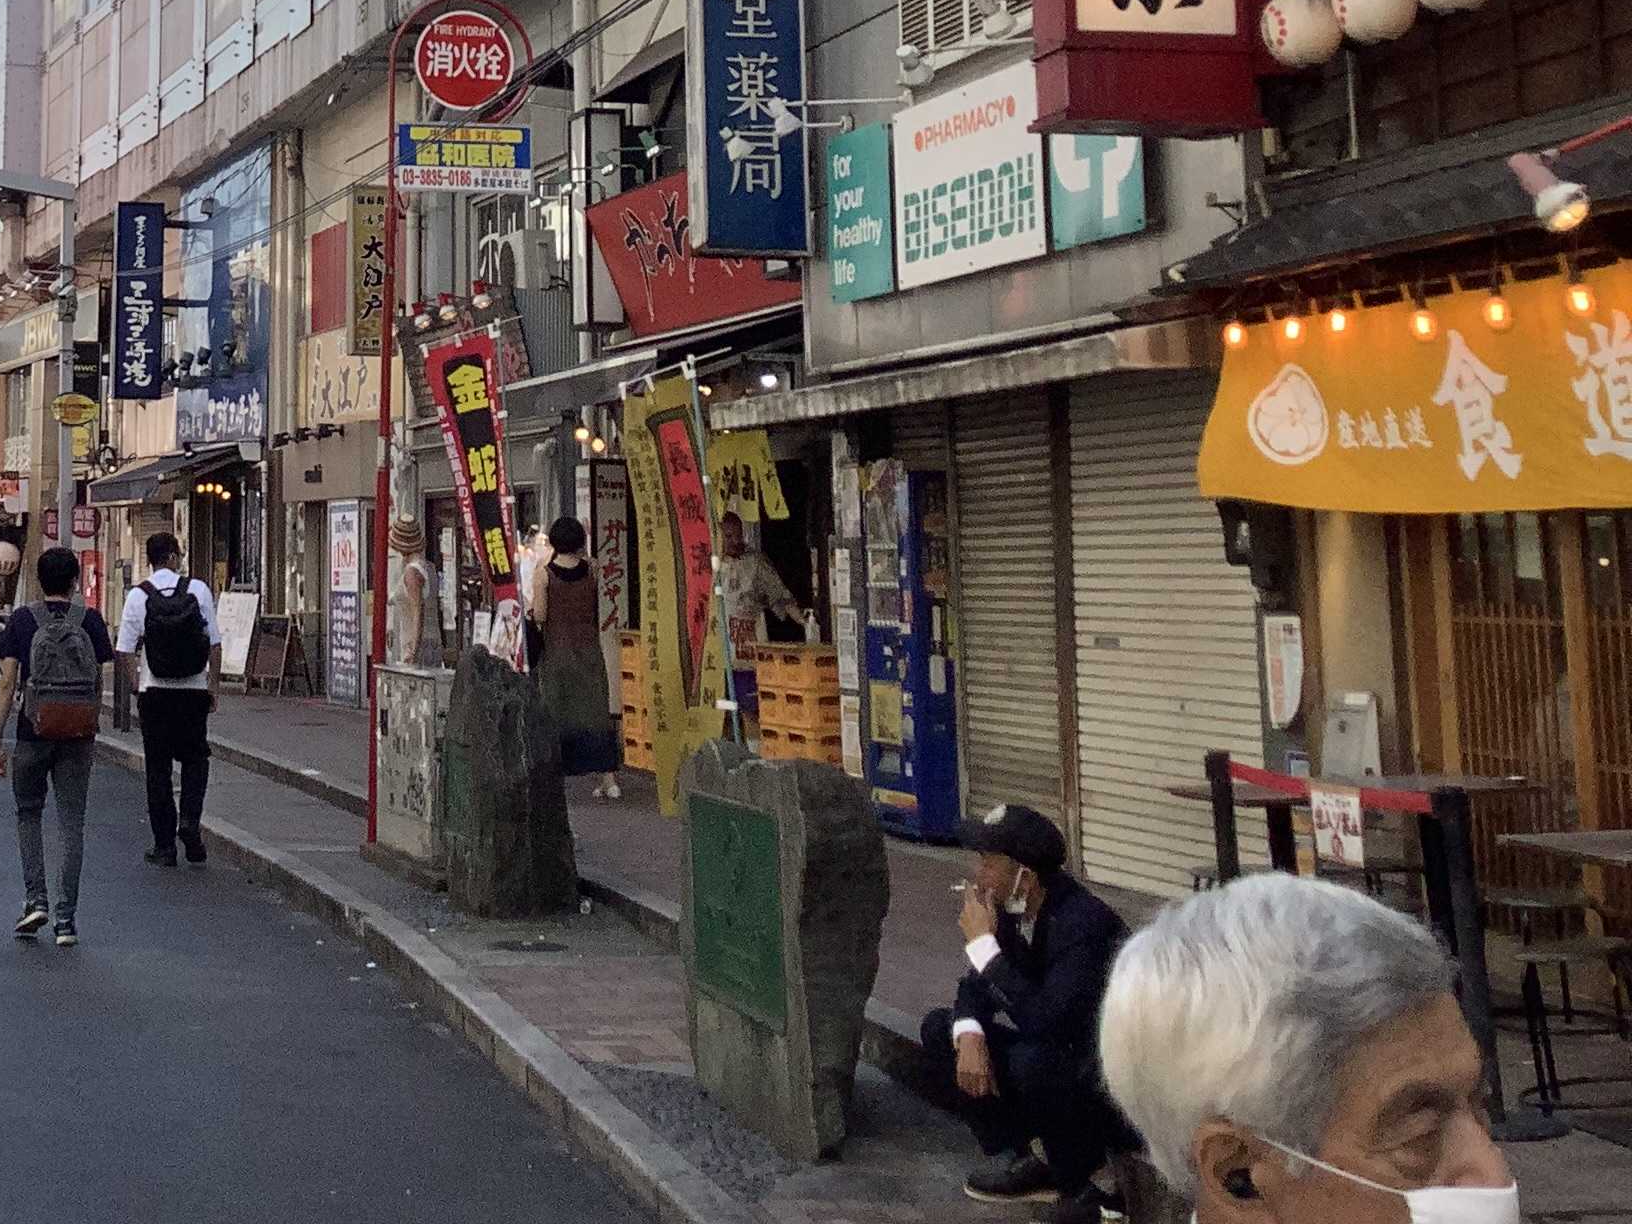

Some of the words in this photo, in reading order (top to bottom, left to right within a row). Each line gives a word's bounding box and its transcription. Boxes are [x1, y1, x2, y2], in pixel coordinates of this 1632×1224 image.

[434, 26, 453, 36] FIRE
[456, 26, 497, 38] HYDRANT
[426, 40, 506, 81] 消火栓
[924, 101, 1007, 151] PHARMACY
[832, 153, 853, 181] for
[833, 186, 865, 218] your
[833, 215, 883, 250] healthy
[360, 234, 386, 320] 大江戸
[833, 259, 856, 286] life
[23, 311, 60, 356] JBWC
